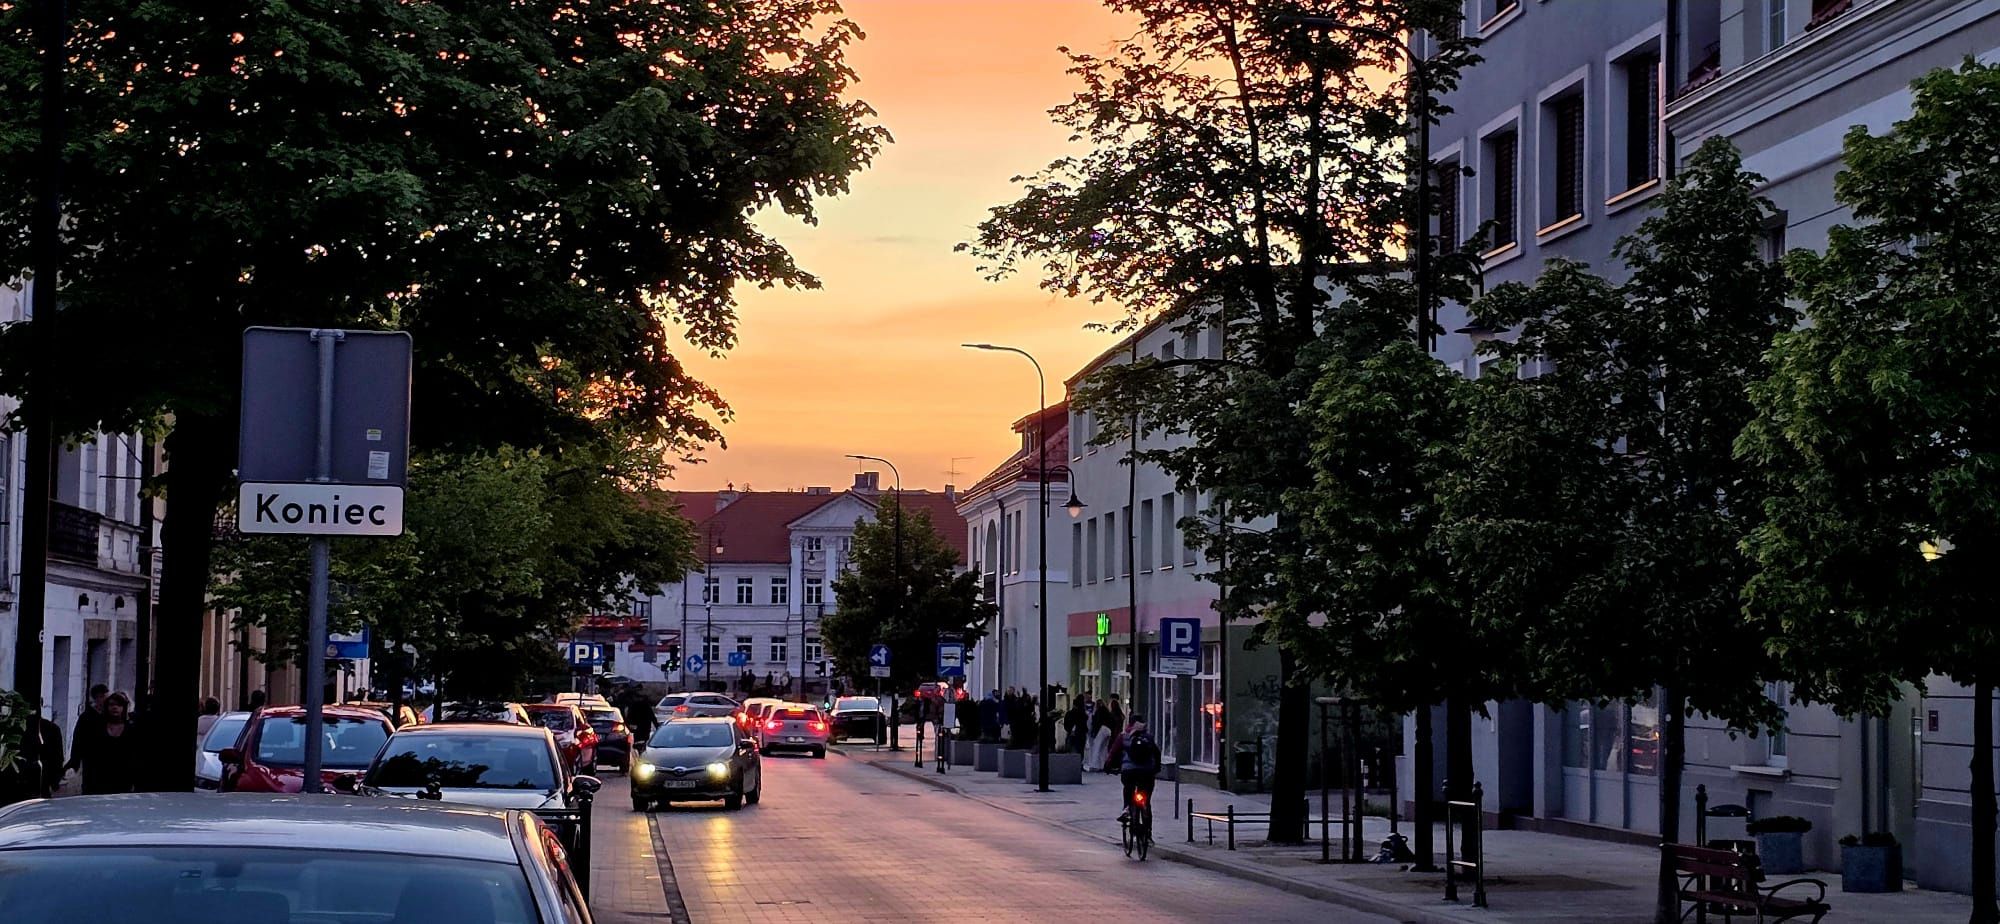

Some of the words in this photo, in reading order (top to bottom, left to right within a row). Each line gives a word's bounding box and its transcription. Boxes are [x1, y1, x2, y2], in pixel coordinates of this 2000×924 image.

[256, 493, 386, 526] Koniec
[1170, 622, 1192, 653] P
[575, 644, 590, 664] P
